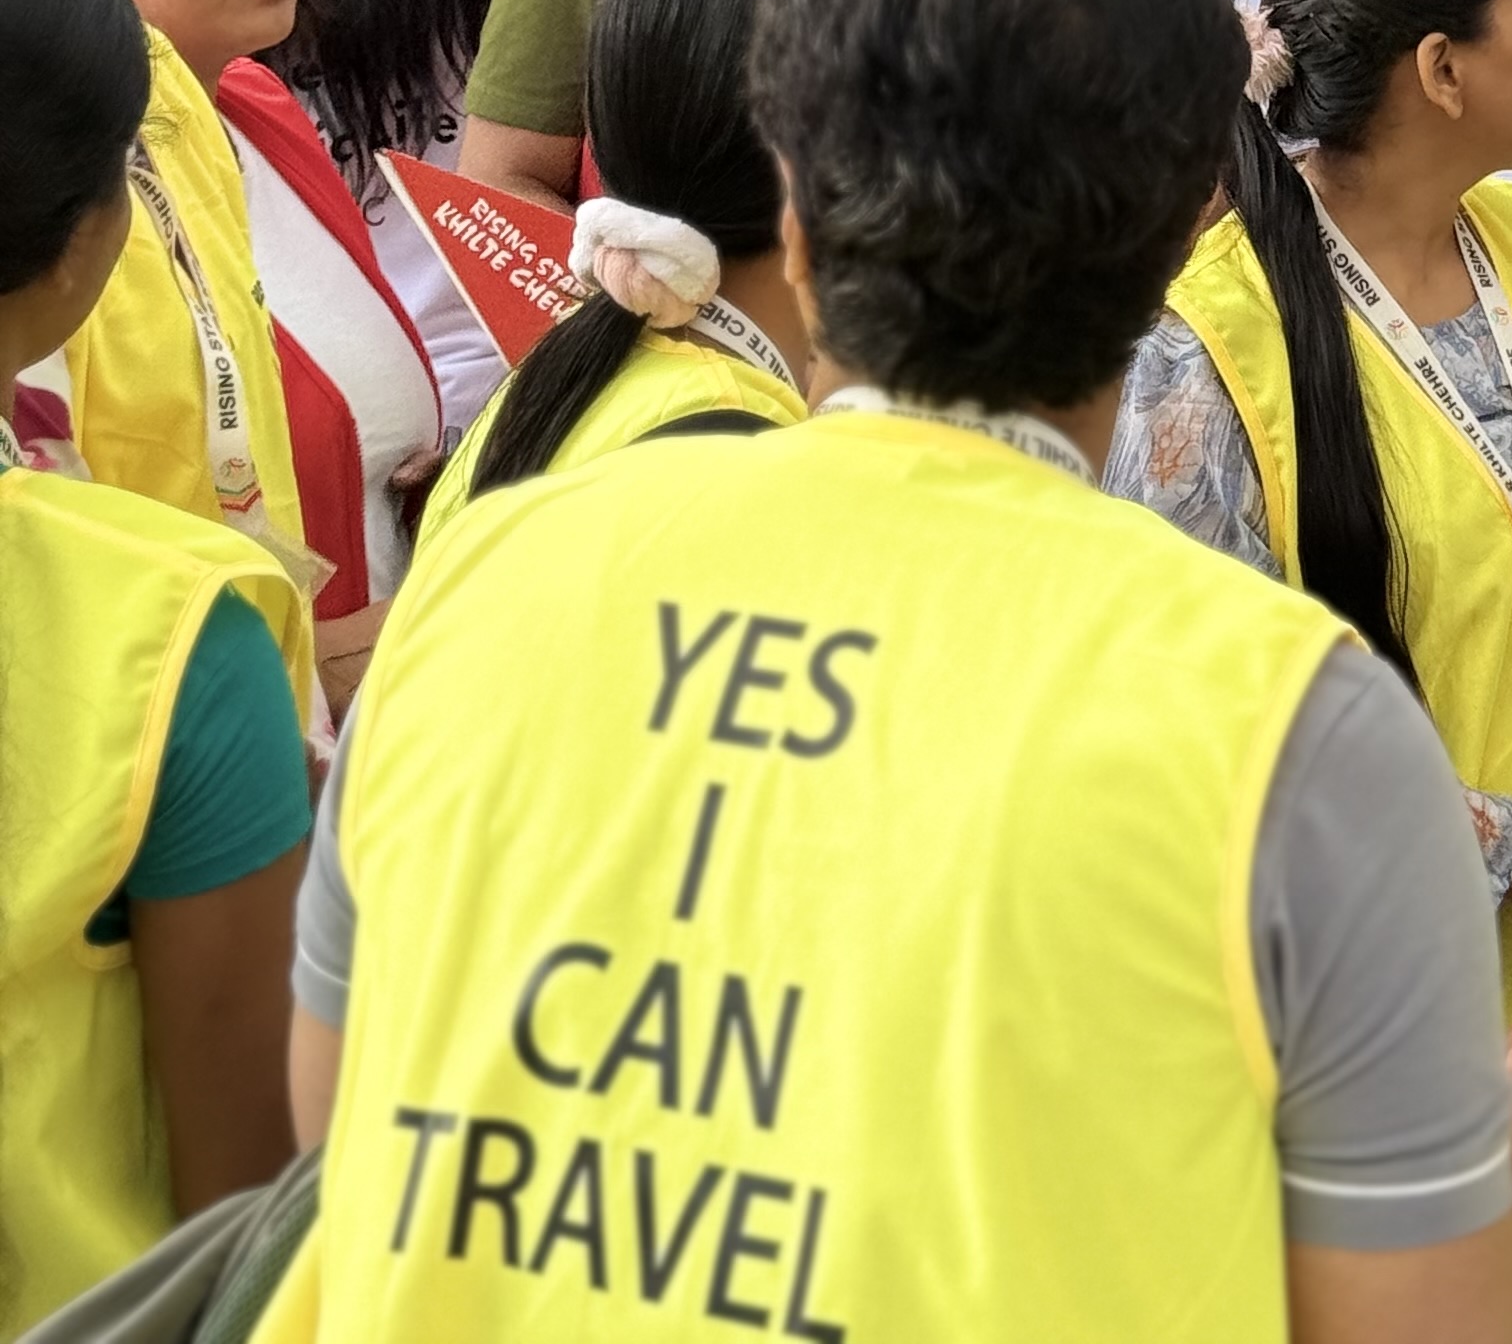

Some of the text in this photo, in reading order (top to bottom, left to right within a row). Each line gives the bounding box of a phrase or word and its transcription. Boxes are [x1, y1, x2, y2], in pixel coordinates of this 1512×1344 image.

[432, 199, 514, 272] KHILTE
[469, 197, 538, 265] RISING
[1462, 236, 1494, 289] RISING
[1333, 252, 1381, 308] RISING
[214, 356, 239, 432] RISING
[744, 332, 795, 389] HILTE
[1414, 355, 1465, 422] CHEHRE
[1463, 422, 1507, 478] KHILTE
[646, 599, 880, 760] YES
[673, 779, 727, 923] I
[510, 940, 804, 1132] CAN
[389, 1103, 848, 1344] TRAVEL
